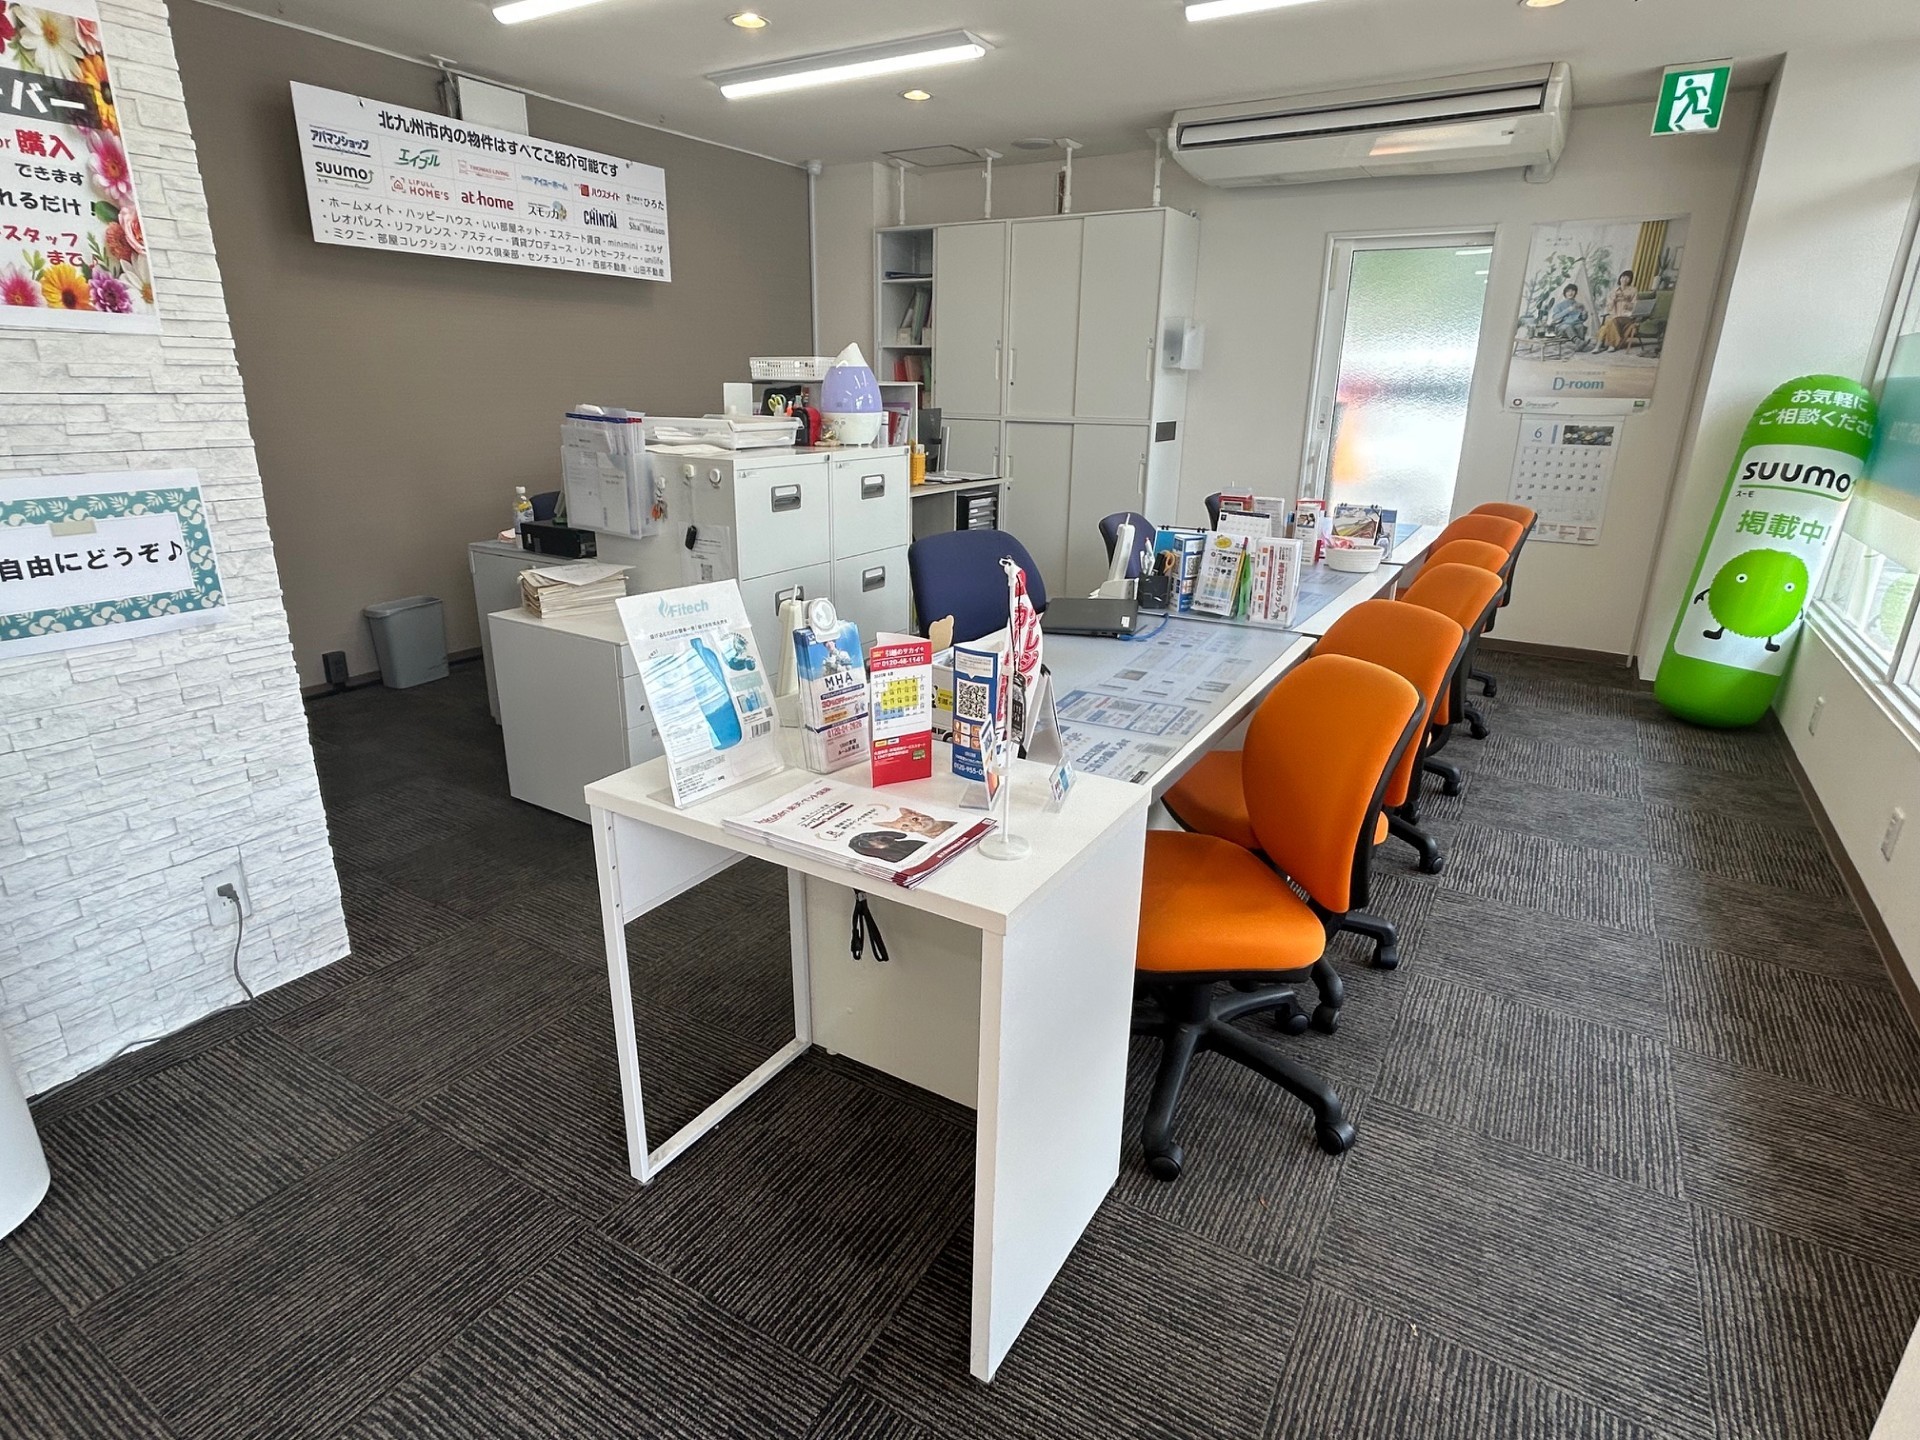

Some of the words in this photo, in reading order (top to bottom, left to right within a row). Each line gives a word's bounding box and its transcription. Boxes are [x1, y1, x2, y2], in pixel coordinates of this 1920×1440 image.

[0, 79, 85, 113] バー
[15, 129, 75, 161] 購入
[310, 129, 369, 150] アパマンショップ
[378, 111, 619, 177] 北九州市内の物件はすべてご紹介可能です
[396, 149, 441, 169] エイブル
[15, 163, 84, 185] できます
[409, 187, 450, 200] HOME'S
[591, 187, 621, 201] ハウスメイト
[528, 205, 559, 220] スモッカ
[583, 208, 618, 228] CHINTAI
[0, 224, 78, 247] スタッフ
[47, 250, 84, 268] まで
[1552, 376, 1605, 391] D-room
[1790, 388, 1868, 412] お気軽に
[1534, 427, 1543, 439] 6
[1735, 490, 1755, 499] スーモ
[1736, 509, 1832, 546] 掲載中!
[669, 600, 709, 618] Fitech
[824, 672, 853, 688] MHA
